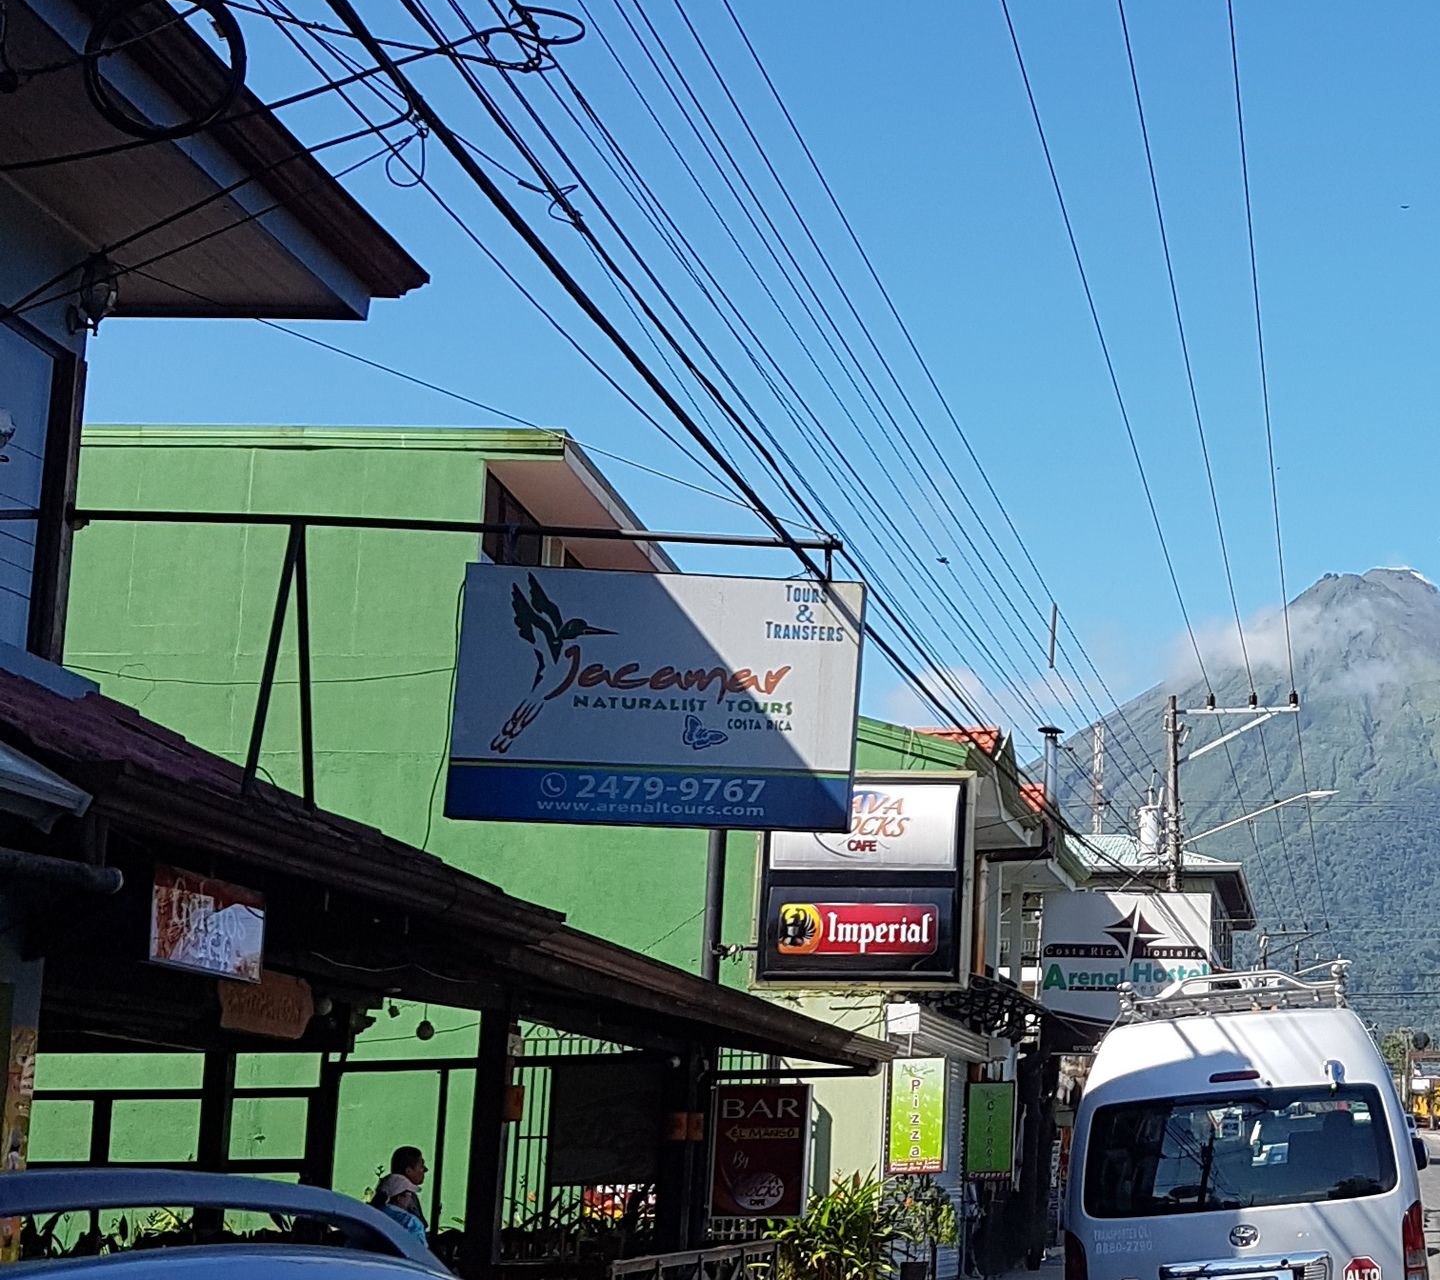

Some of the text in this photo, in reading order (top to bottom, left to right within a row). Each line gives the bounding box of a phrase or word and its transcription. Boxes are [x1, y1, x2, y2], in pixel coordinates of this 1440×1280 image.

[785, 584, 828, 604] TOURS
[795, 604, 815, 624] &
[765, 621, 845, 642] TRANSFERS
[544, 644, 792, 705] Jacamar
[573, 694, 793, 717] NATURALIST TOURS
[727, 718, 793, 732] COSTA RICA
[576, 774, 767, 803] 2479-9767
[536, 799, 765, 817] www.arenaltours.com
[852, 794, 904, 815] AVA
[850, 816, 910, 838] OCKS
[827, 911, 931, 953] Imperial
[1045, 946, 1085, 956] Costa
[1042, 961, 1210, 991] Arenal Hostel
[721, 1097, 801, 1119] BAR
[910, 1079, 922, 1158] Pizza
